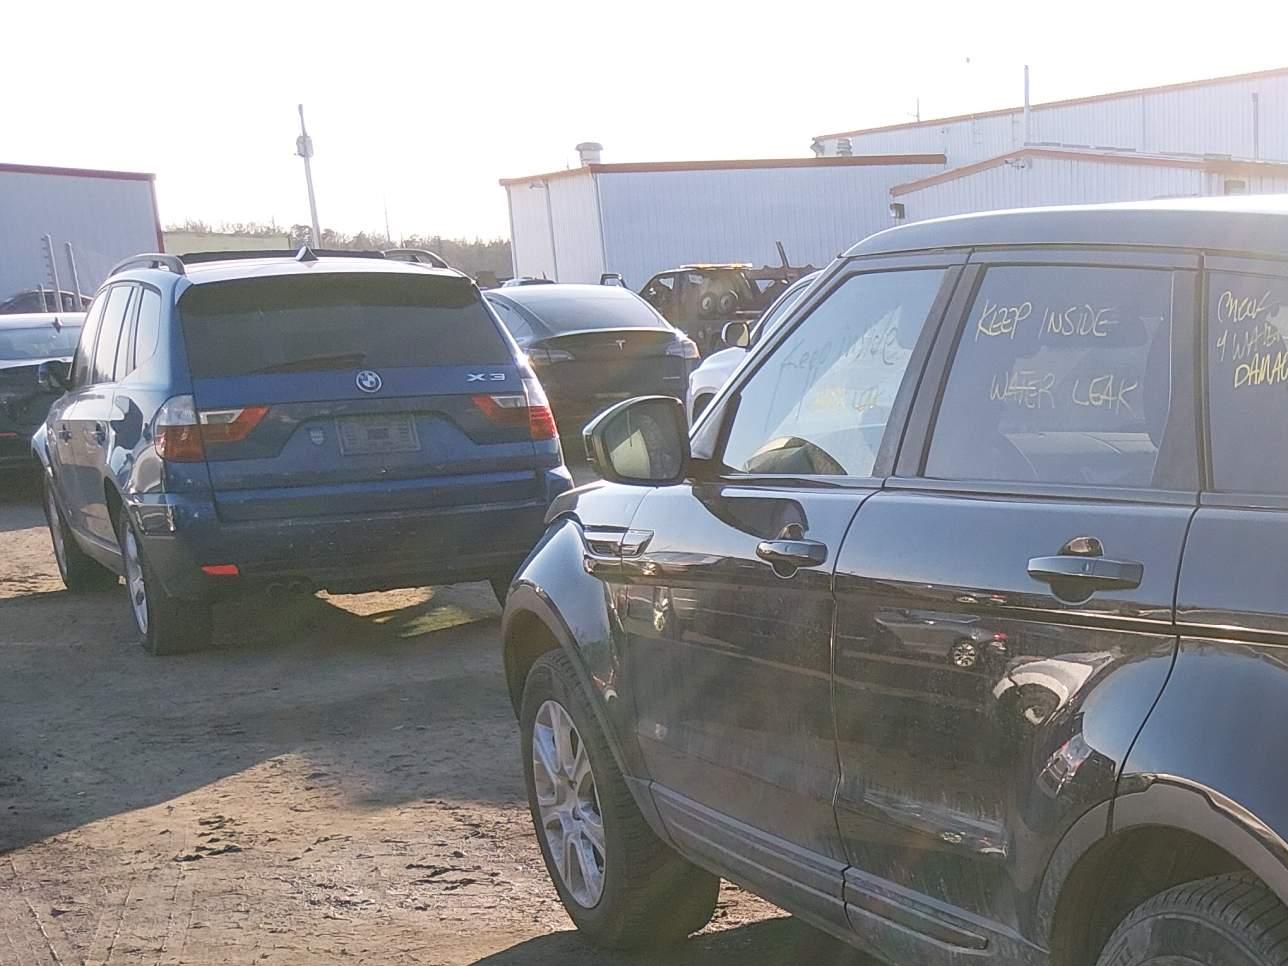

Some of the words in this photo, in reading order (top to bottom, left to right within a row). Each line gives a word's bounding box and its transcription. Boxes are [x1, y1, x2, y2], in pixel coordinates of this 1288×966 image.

[975, 299, 1033, 341] KEEP
[1038, 303, 1117, 340] INSIDE
[989, 369, 1057, 409] WATER
[1071, 373, 1140, 419] LEAK
